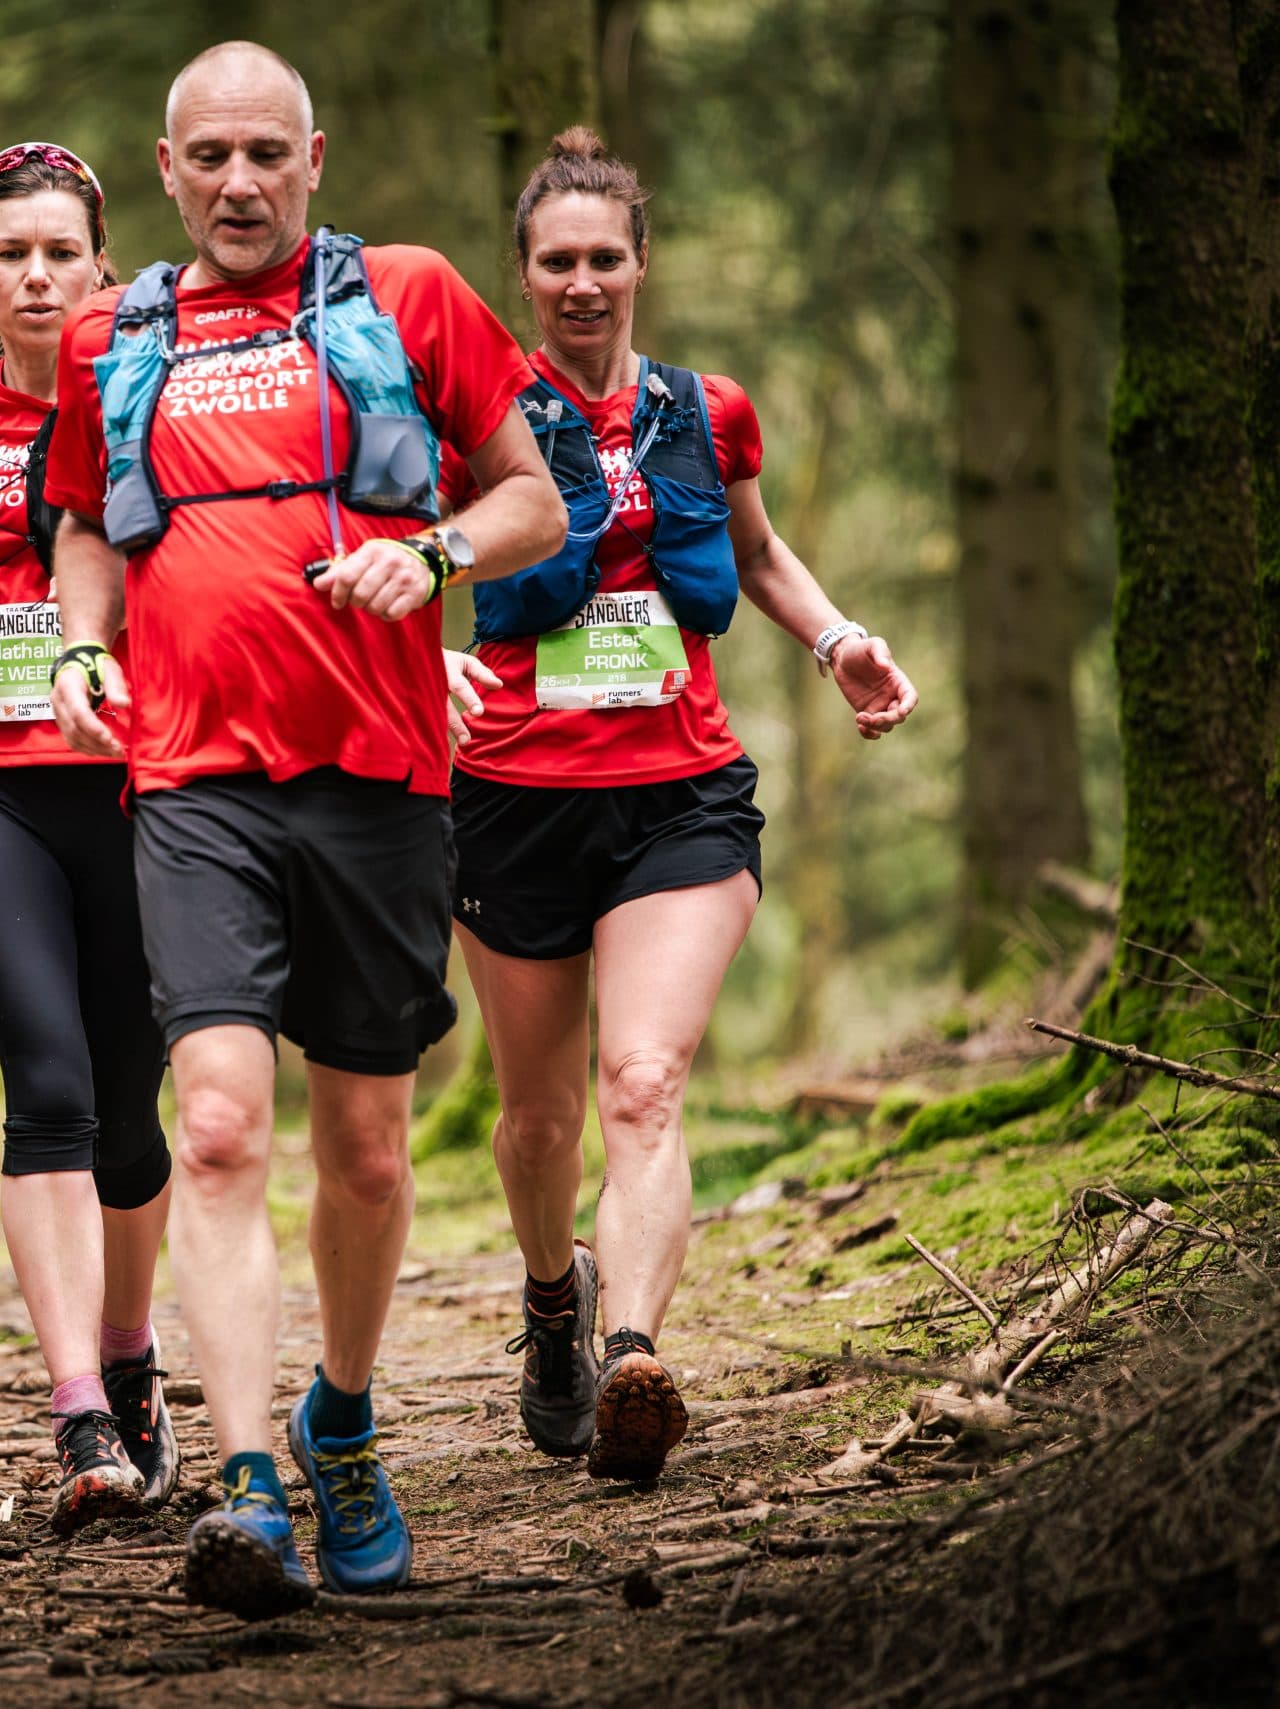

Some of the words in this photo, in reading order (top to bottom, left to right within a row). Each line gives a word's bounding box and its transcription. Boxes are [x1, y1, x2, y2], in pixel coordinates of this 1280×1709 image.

[194, 308, 244, 325] CRAFT
[161, 369, 312, 399] OOPSPORT
[169, 389, 288, 417] ZWOLLE
[589, 632, 643, 648] Ester
[584, 653, 648, 670] PRONK
